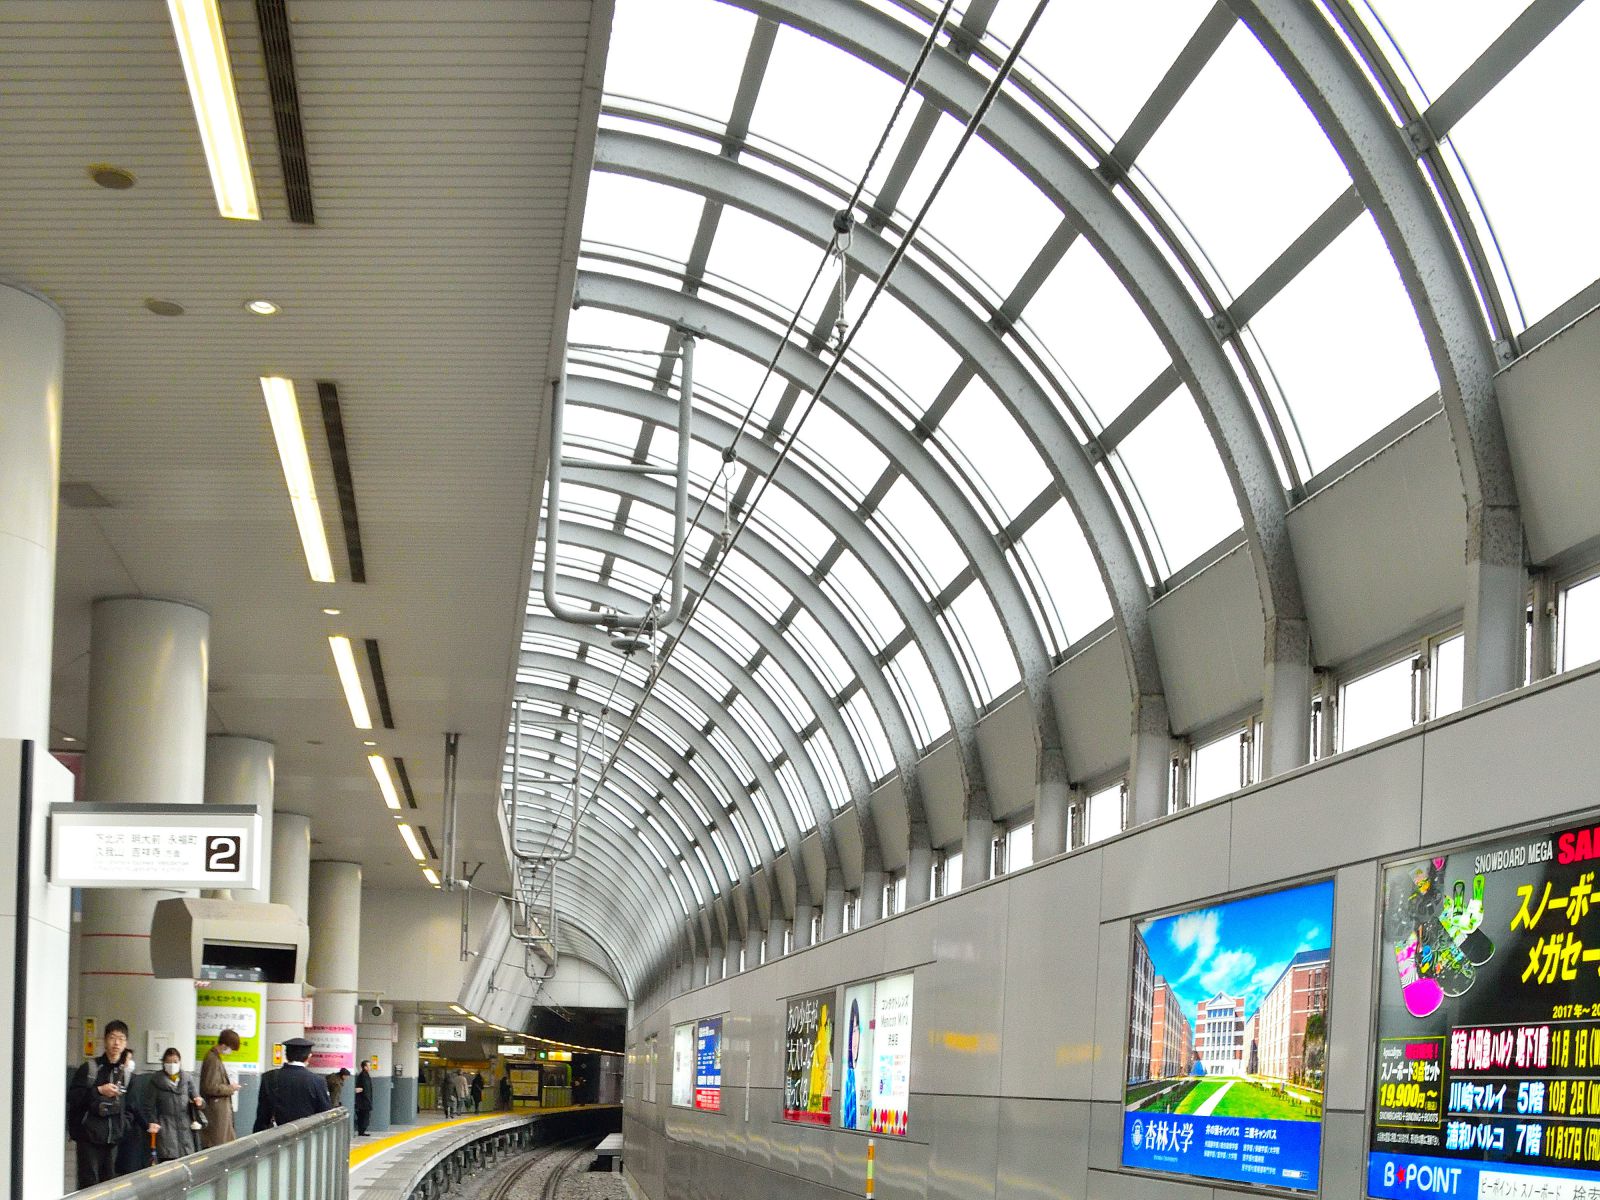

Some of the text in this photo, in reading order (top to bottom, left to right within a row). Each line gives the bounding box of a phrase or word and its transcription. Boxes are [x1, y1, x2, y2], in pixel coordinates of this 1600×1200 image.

[209, 837, 237, 870] 2
[1474, 846, 1526, 874] SNOWBOARD
[1528, 840, 1553, 864] MEGA
[1521, 931, 1600, 985] メガセー
[1552, 1030, 1570, 1068] 11月
[1575, 1029, 1588, 1068] 1日
[1448, 1081, 1507, 1113] 川崎マルイ
[1517, 1081, 1545, 1115] 5階
[1549, 1080, 1567, 1115] 10月
[1570, 1081, 1586, 1116] 2日
[1145, 1120, 1194, 1153] 杏林大学
[1446, 1121, 1505, 1151] 浦和パルコ
[1516, 1123, 1543, 1156] 7階
